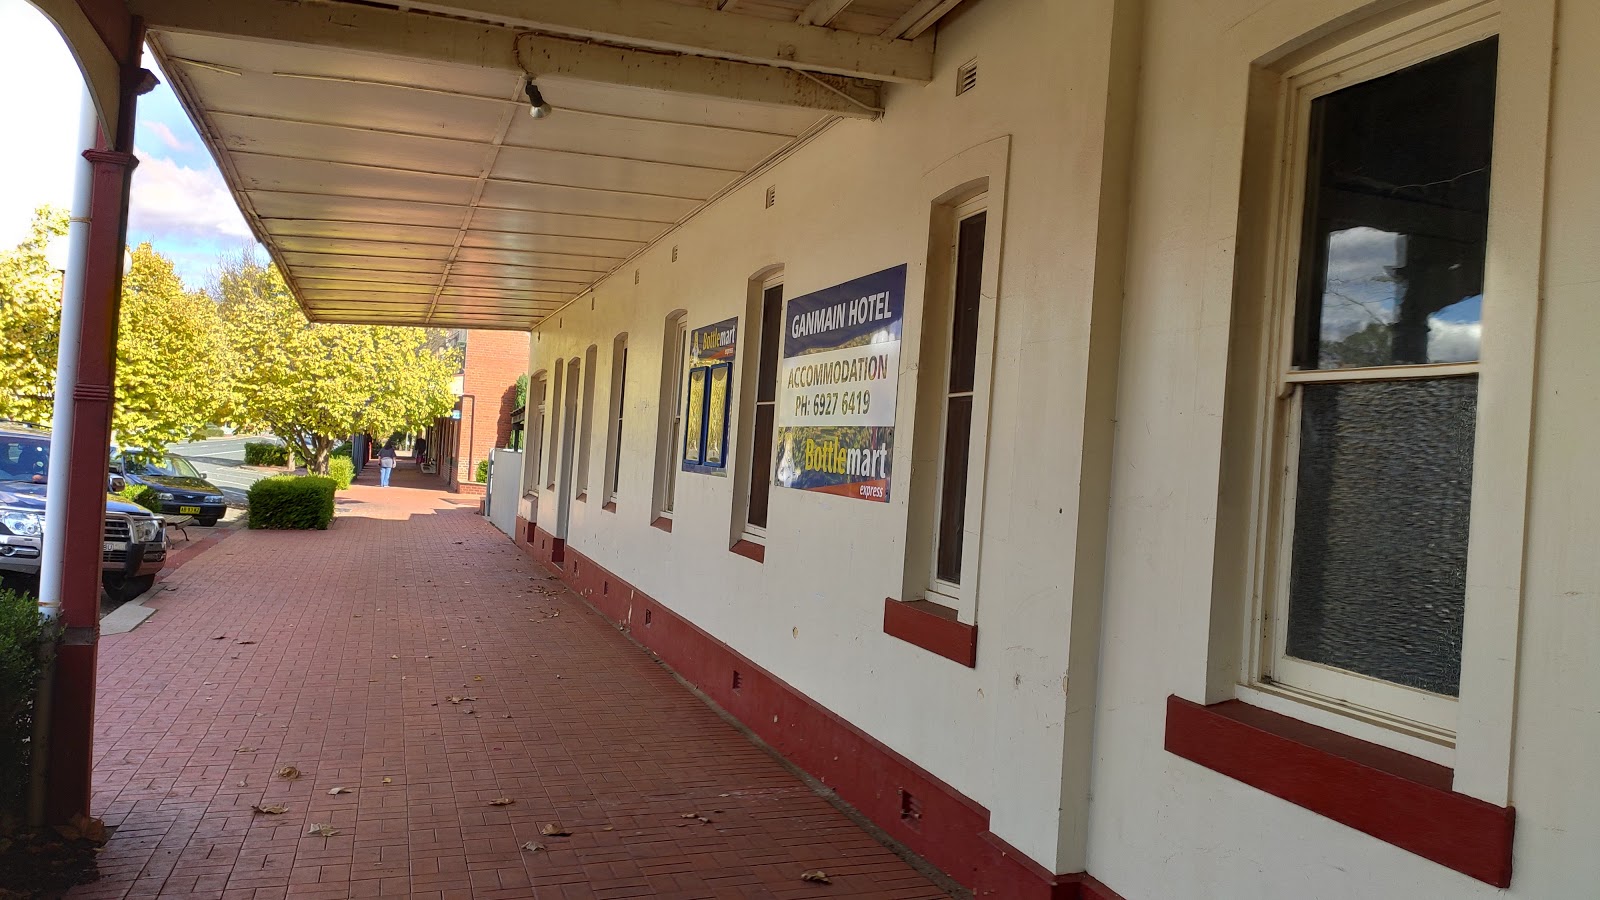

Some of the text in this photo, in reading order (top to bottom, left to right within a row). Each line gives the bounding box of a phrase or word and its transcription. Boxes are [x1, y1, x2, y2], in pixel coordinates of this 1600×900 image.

[791, 291, 891, 339] GANMAIN HOTEL
[703, 325, 735, 350] Bottlemart
[787, 354, 889, 389] ACCOMMODATION
[795, 389, 871, 416] PH: 6927 6419
[805, 437, 887, 478] Bottlemart
[859, 484, 884, 499] express
